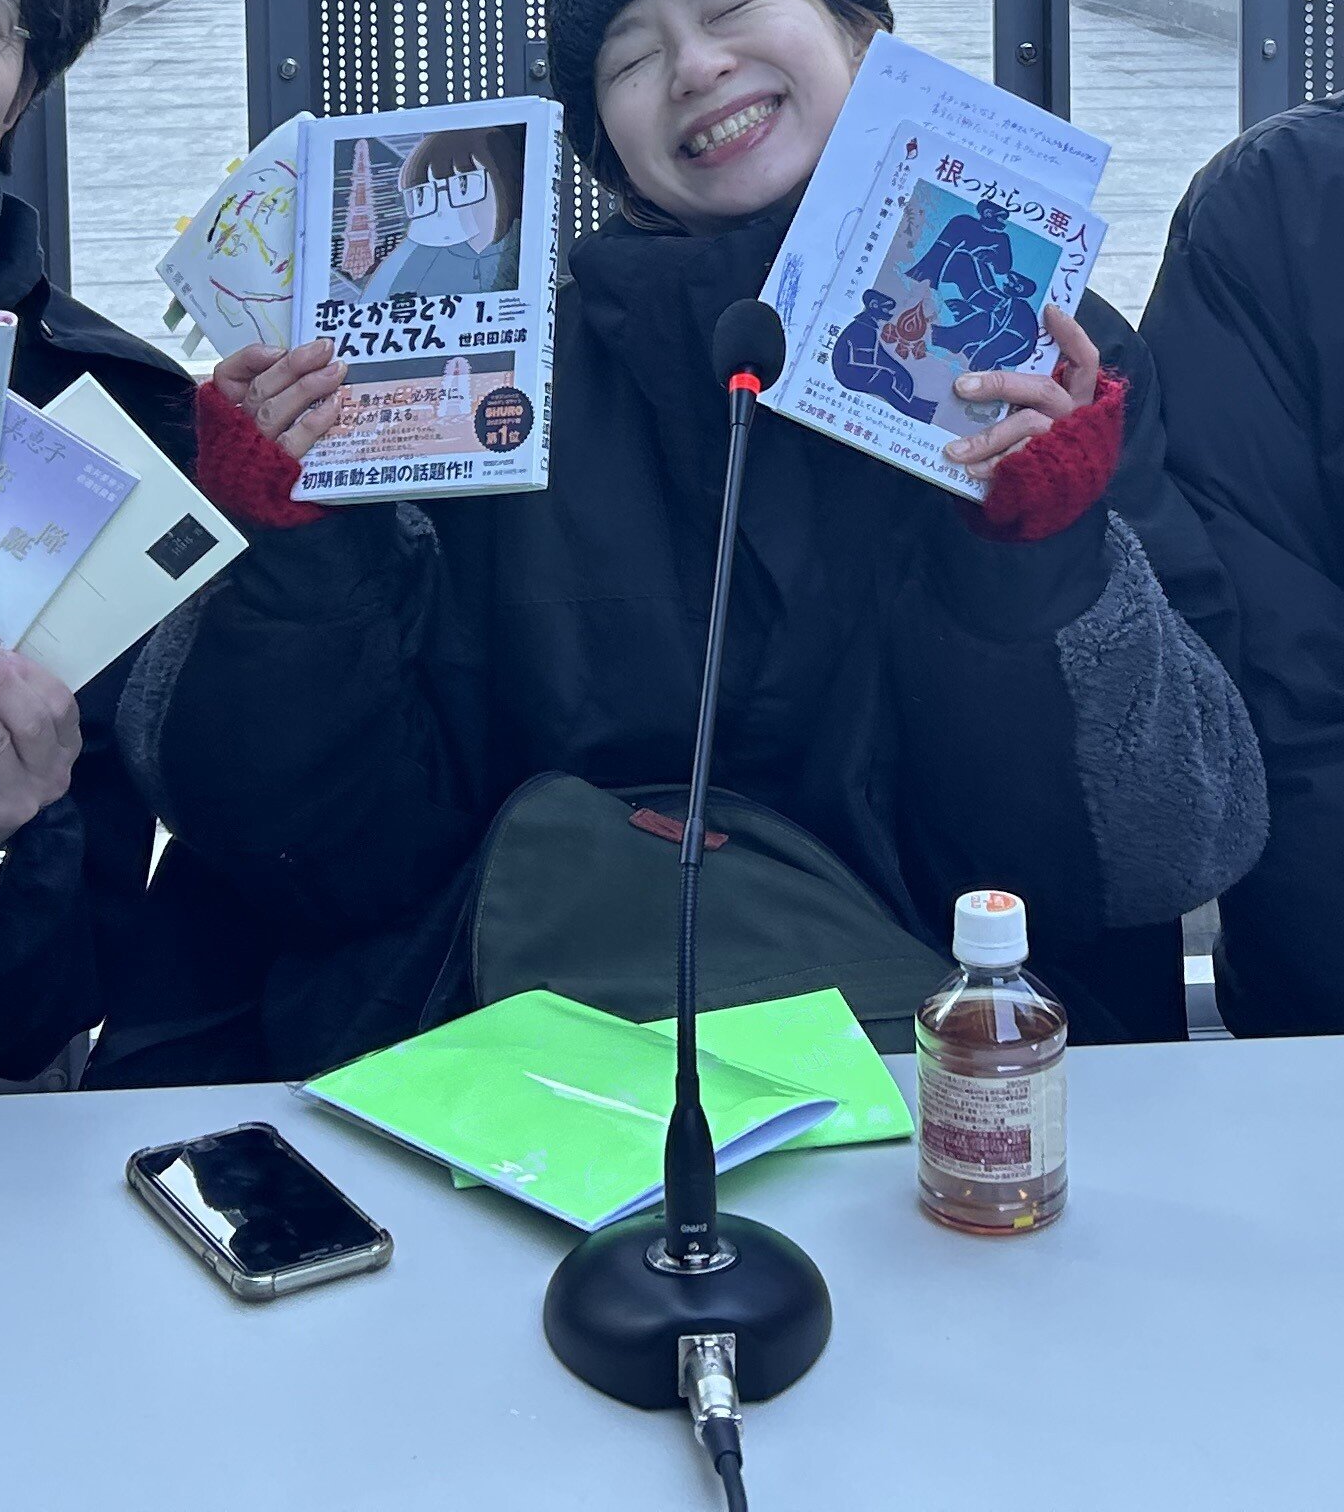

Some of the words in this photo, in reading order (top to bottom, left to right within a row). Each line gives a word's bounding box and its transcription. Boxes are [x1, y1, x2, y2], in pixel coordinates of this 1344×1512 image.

[935, 153, 1089, 253] 根っからの悪人
[315, 292, 462, 331] 恋とか夢とか
[476, 301, 493, 323] 1.
[301, 461, 473, 491] 初期衝動全開の話題作!!
